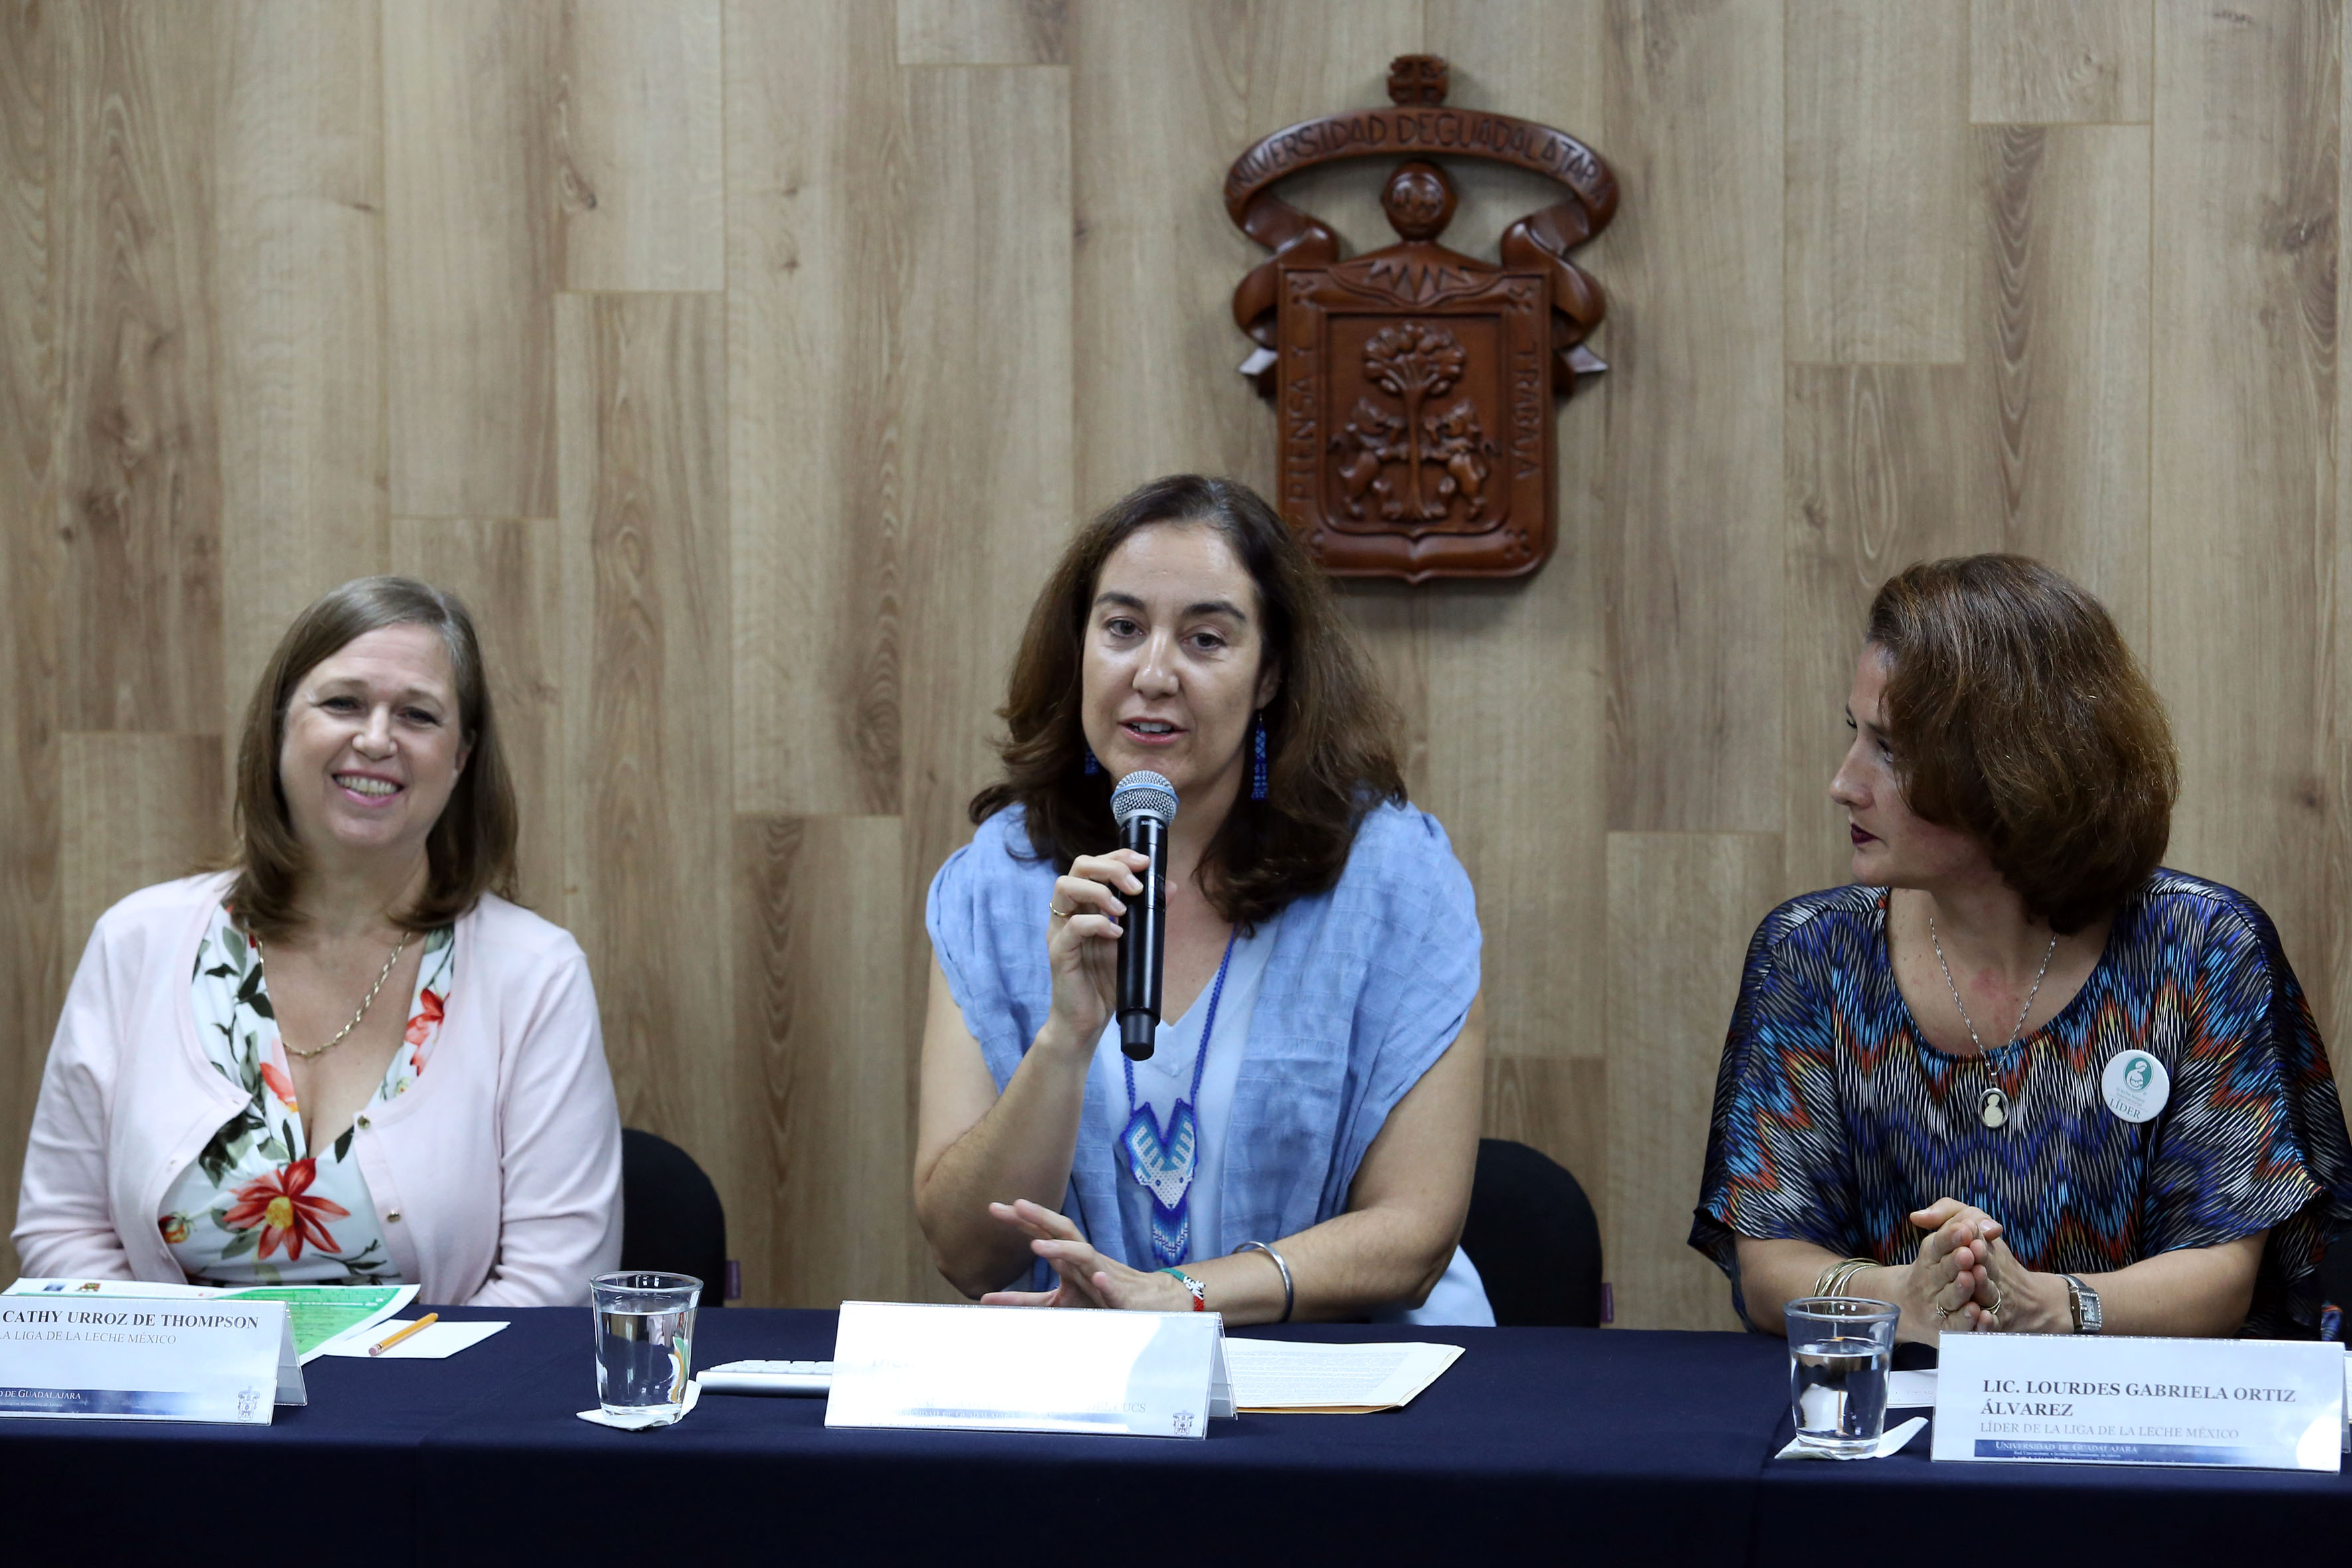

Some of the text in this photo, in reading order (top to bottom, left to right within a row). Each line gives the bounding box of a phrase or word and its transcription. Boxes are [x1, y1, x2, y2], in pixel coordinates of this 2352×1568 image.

[2110, 1098, 2140, 1119] LÍDER
[3, 1310, 259, 1329] CATHY URROZ DE THOMPSON
[15, 1330, 42, 1340] LIGA
[46, 1331, 62, 1341] DE
[66, 1331, 81, 1341] LA
[85, 1332, 125, 1342] LECHE
[128, 1332, 177, 1344] MÉXICO
[18, 1389, 81, 1400] GUADALAJARA
[1983, 1379, 2297, 1403] LIC. LOURDES GABRIELA ORTIZ
[1980, 1398, 2073, 1417] ÁLVAREZ
[1980, 1421, 2239, 1439] LÍDER DE LA LIGA DE LA LECHE MÉXICO
[1996, 1441, 2055, 1450] UNIVERSIDAD
